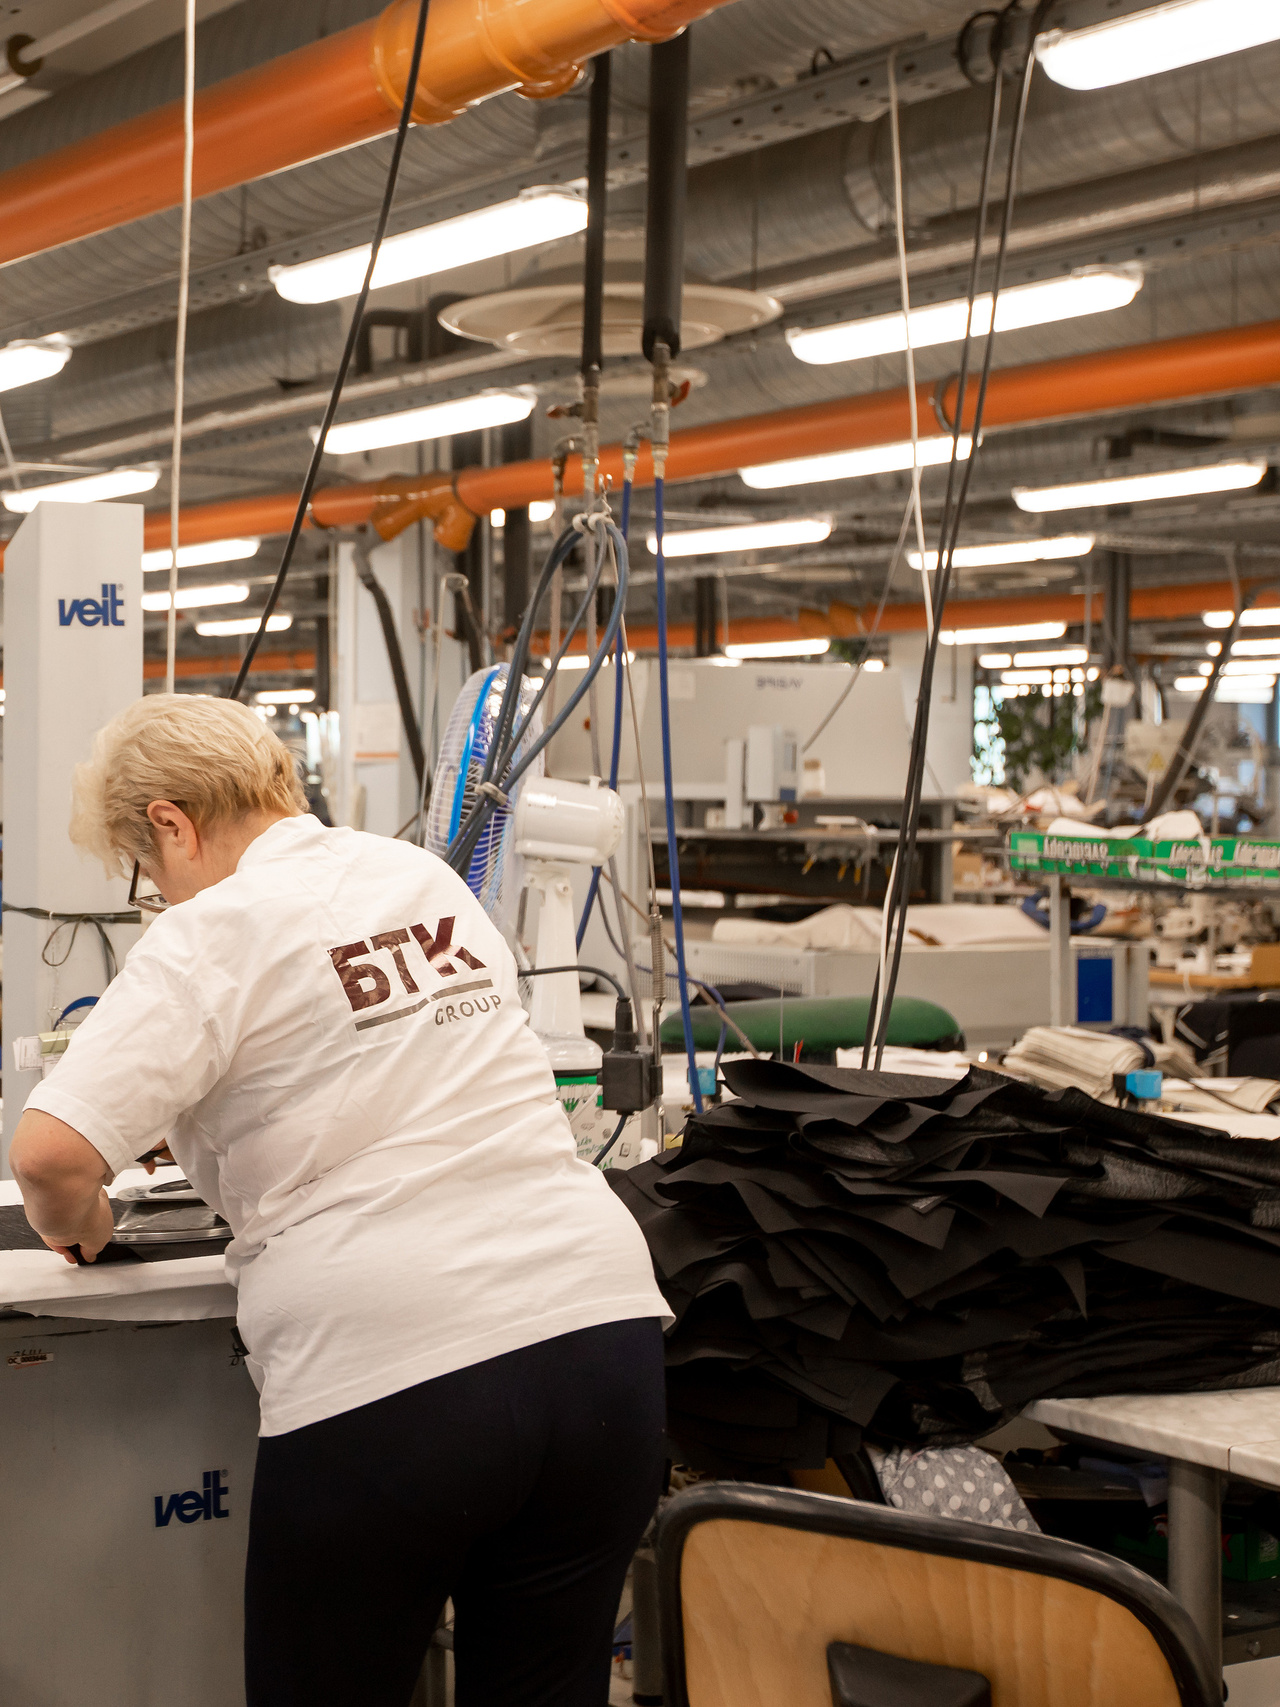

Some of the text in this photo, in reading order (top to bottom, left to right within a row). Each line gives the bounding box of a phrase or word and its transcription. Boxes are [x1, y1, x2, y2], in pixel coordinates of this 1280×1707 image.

[58, 583, 125, 627] veit
[327, 916, 487, 1012] БТК
[434, 994, 501, 1025] GROUP
[154, 1469, 230, 1528] veit
